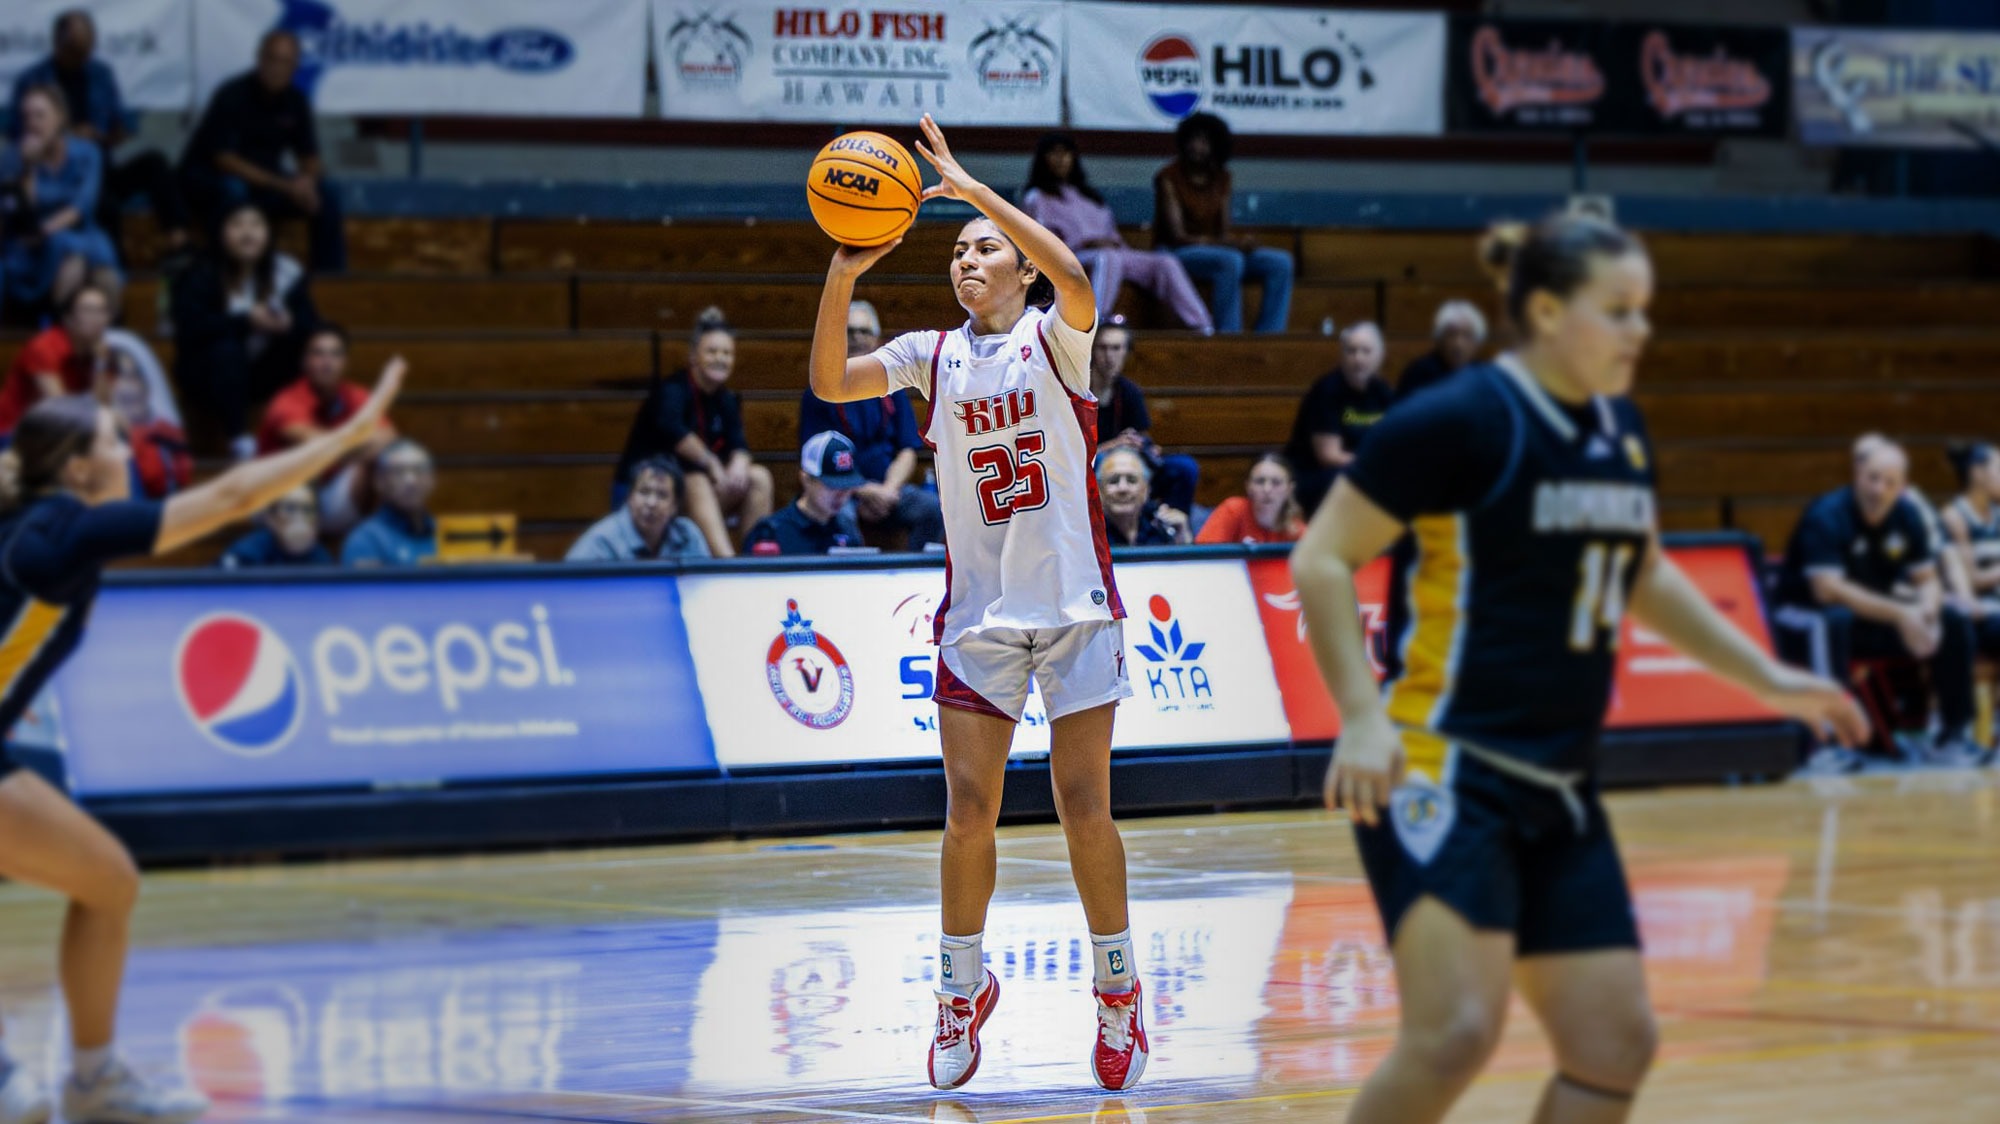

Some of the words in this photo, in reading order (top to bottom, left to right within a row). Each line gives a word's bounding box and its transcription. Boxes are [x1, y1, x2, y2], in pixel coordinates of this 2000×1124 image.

[774, 9, 860, 38] HILO
[870, 11, 946, 40] FISH
[1213, 45, 1342, 88] HILO
[782, 79, 946, 107] HAWAII
[823, 167, 880, 196] NCAA
[968, 430, 1050, 526] 25
[312, 604, 562, 714] pepsi
[1146, 665, 1213, 699] KTA
